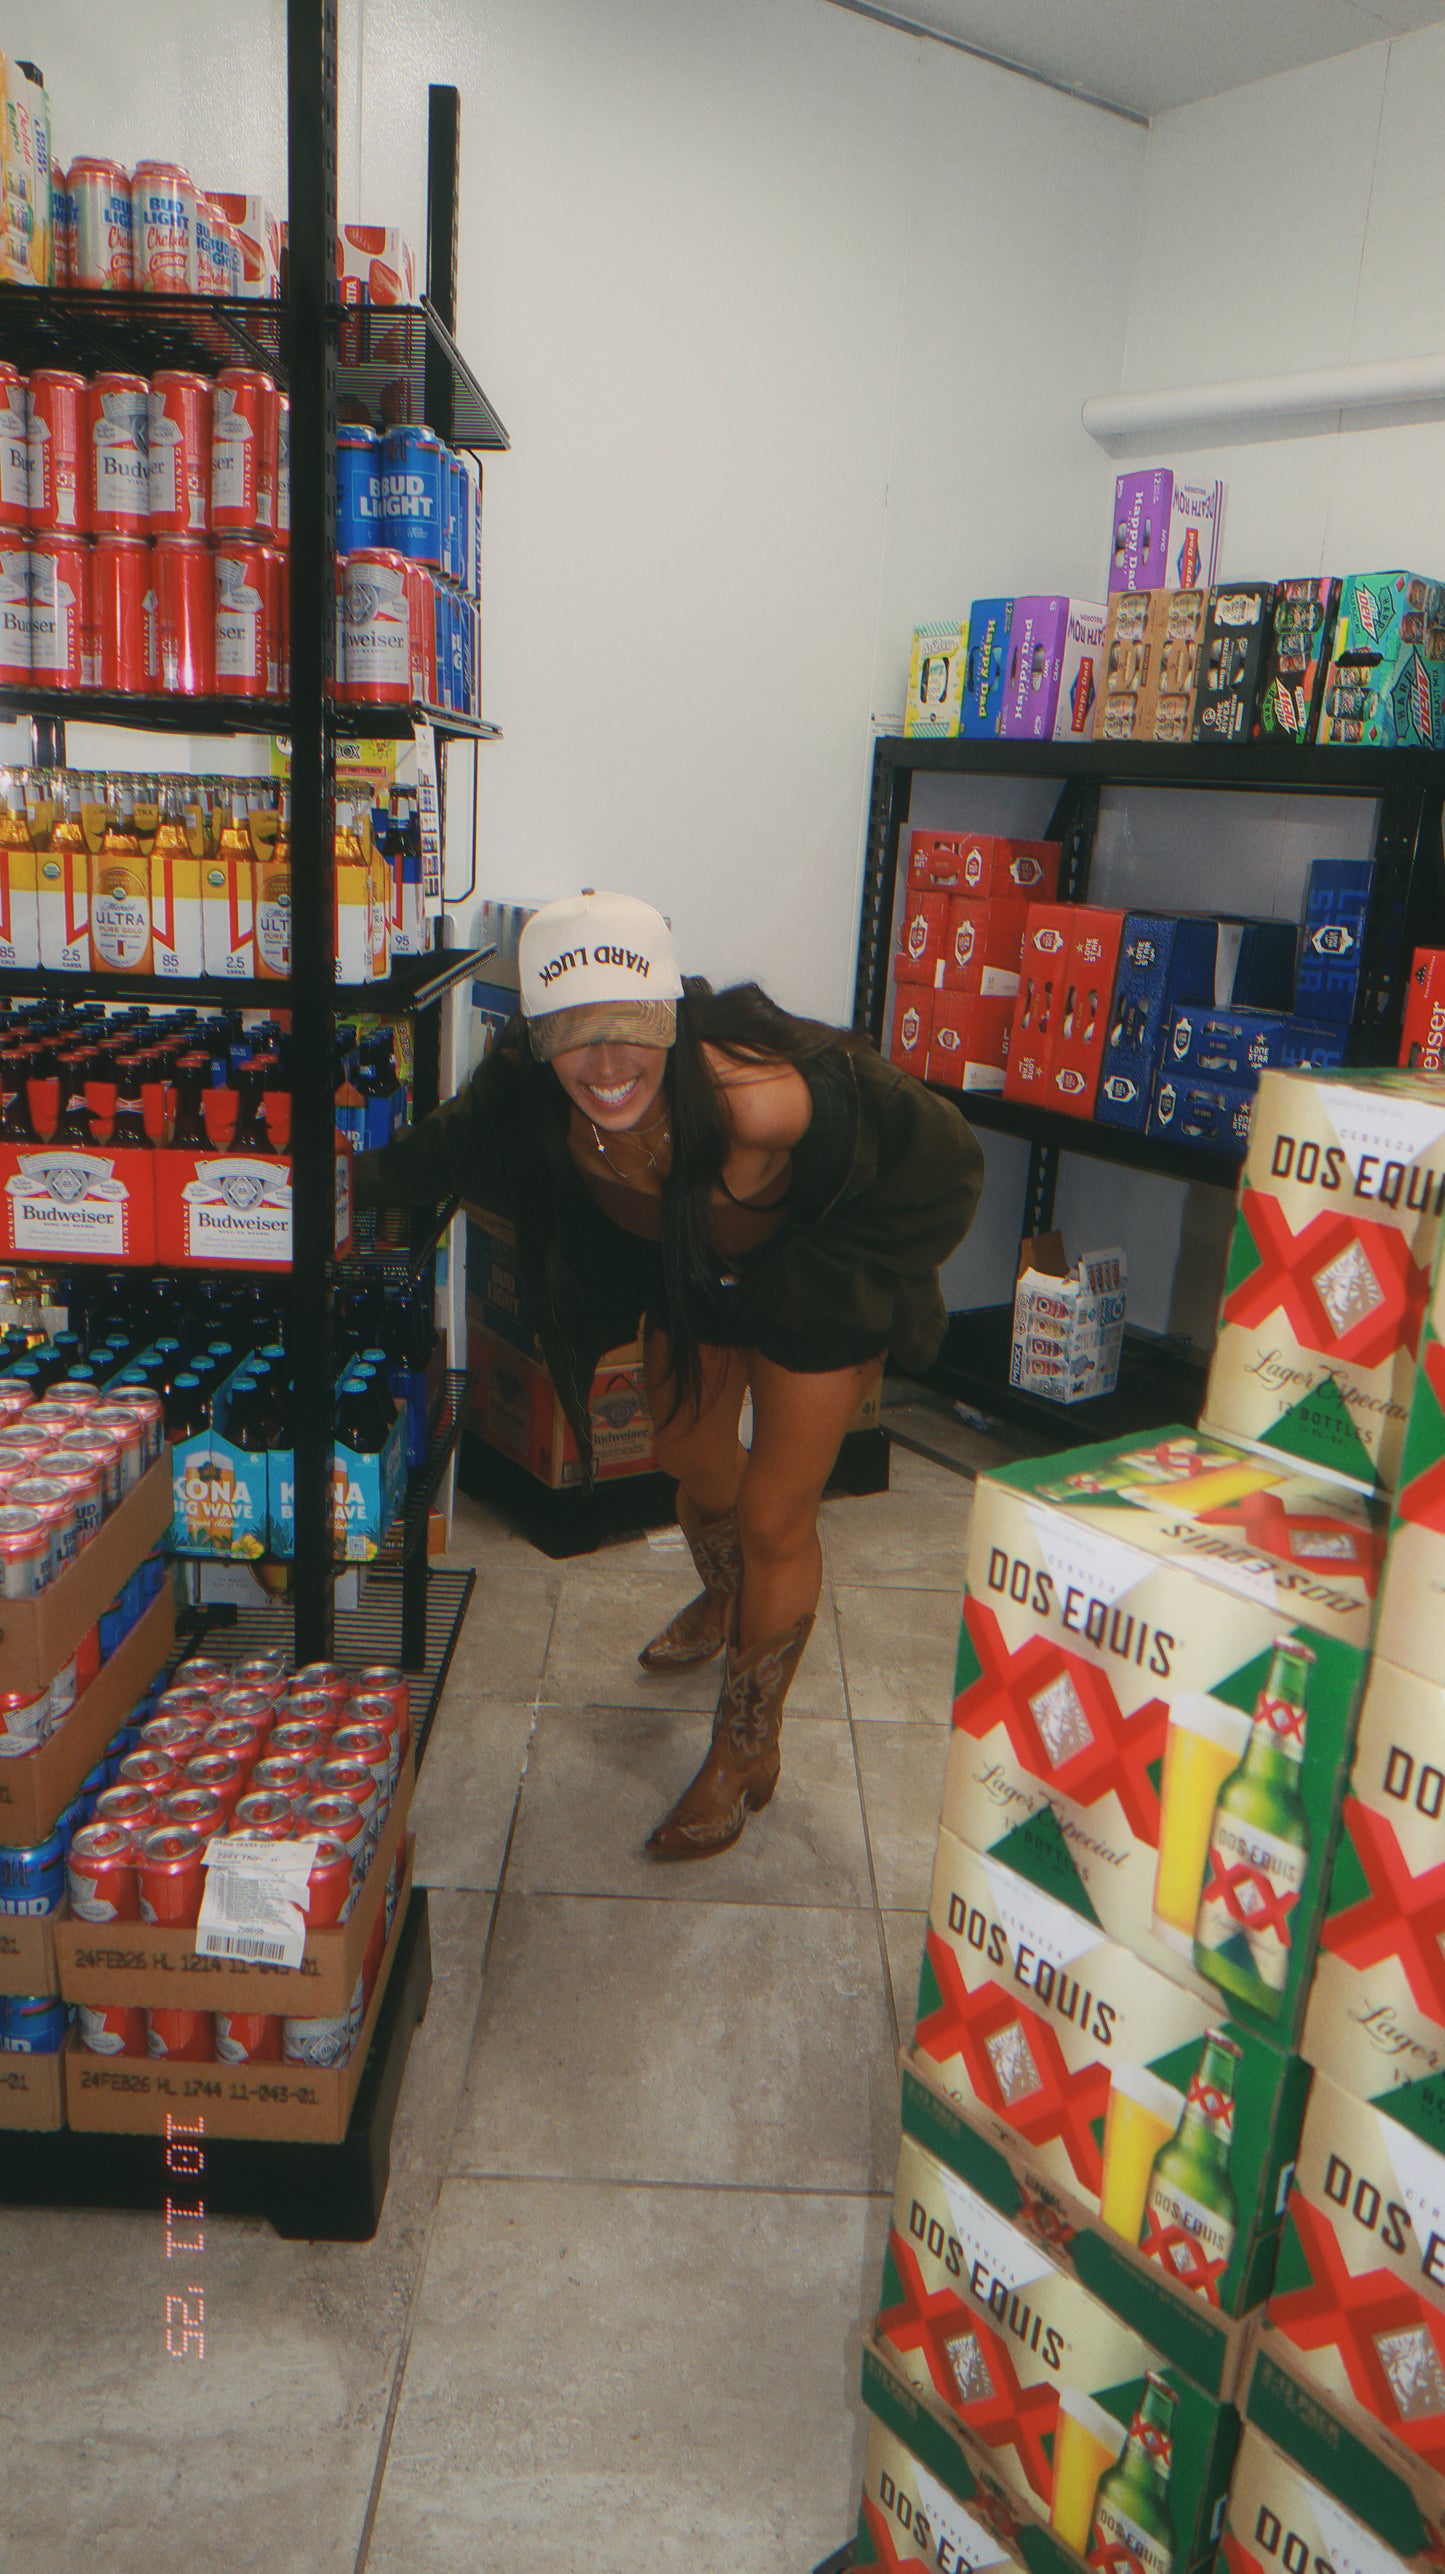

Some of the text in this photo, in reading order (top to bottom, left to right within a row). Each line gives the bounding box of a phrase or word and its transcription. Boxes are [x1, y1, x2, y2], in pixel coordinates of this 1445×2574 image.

[104, 208, 132, 231] LIG
[110, 196, 132, 215] BU
[143, 210, 190, 230] LIGHT
[149, 196, 184, 214] BUD
[145, 226, 189, 250] Chelada
[1127, 491, 1144, 591] Happy Dad
[979, 619, 996, 718] Happy Dad
[1014, 618, 1033, 719] Happy Dad
[96, 911, 145, 926] ULTRA
[261, 918, 289, 932] ULT
[62, 949, 81, 962] 2.5
[162, 954, 179, 967] 85
[395, 936, 410, 946] 95
[226, 956, 245, 969] 2.5
[537, 944, 651, 988] HARD LUCK
[1248, 1052, 1269, 1064] STAR
[1249, 1045, 1269, 1056] LONE
[1340, 1128, 1416, 1153] CERVEZA
[1271, 1135, 1445, 1217] DOS EQUI
[22, 1204, 115, 1225] Budweiser
[197, 1212, 289, 1232] Budweiser
[1244, 1348, 1315, 1392] Lager
[1300, 1408, 1373, 1445] BOTTLES
[202, 1502, 253, 1519] WAVE
[1047, 1553, 1117, 1595] CERVEZA
[1160, 1524, 1366, 1614] DOS EQUIS
[987, 1546, 1176, 1679] DOS EQUIS
[1384, 1744, 1445, 1820] DO
[972, 1759, 1132, 1868] Lager Especial
[1218, 1827, 1297, 1883] DOS EQUIS
[1001, 1910, 1063, 1961] CERVEZA
[75, 1949, 148, 1969] 24FEB26
[948, 1892, 1117, 2047] DOS EQUIS
[1347, 1999, 1440, 2068] Lager
[80, 2070, 150, 2091] 24FEB26
[1154, 2190, 1226, 2252] DOS EQUIS
[1324, 2153, 1412, 2256] DOS
[958, 2226, 1016, 2284] CERVEZA
[909, 2199, 1065, 2371] DOS EQUIS
[880, 2469, 931, 2550] DOS
